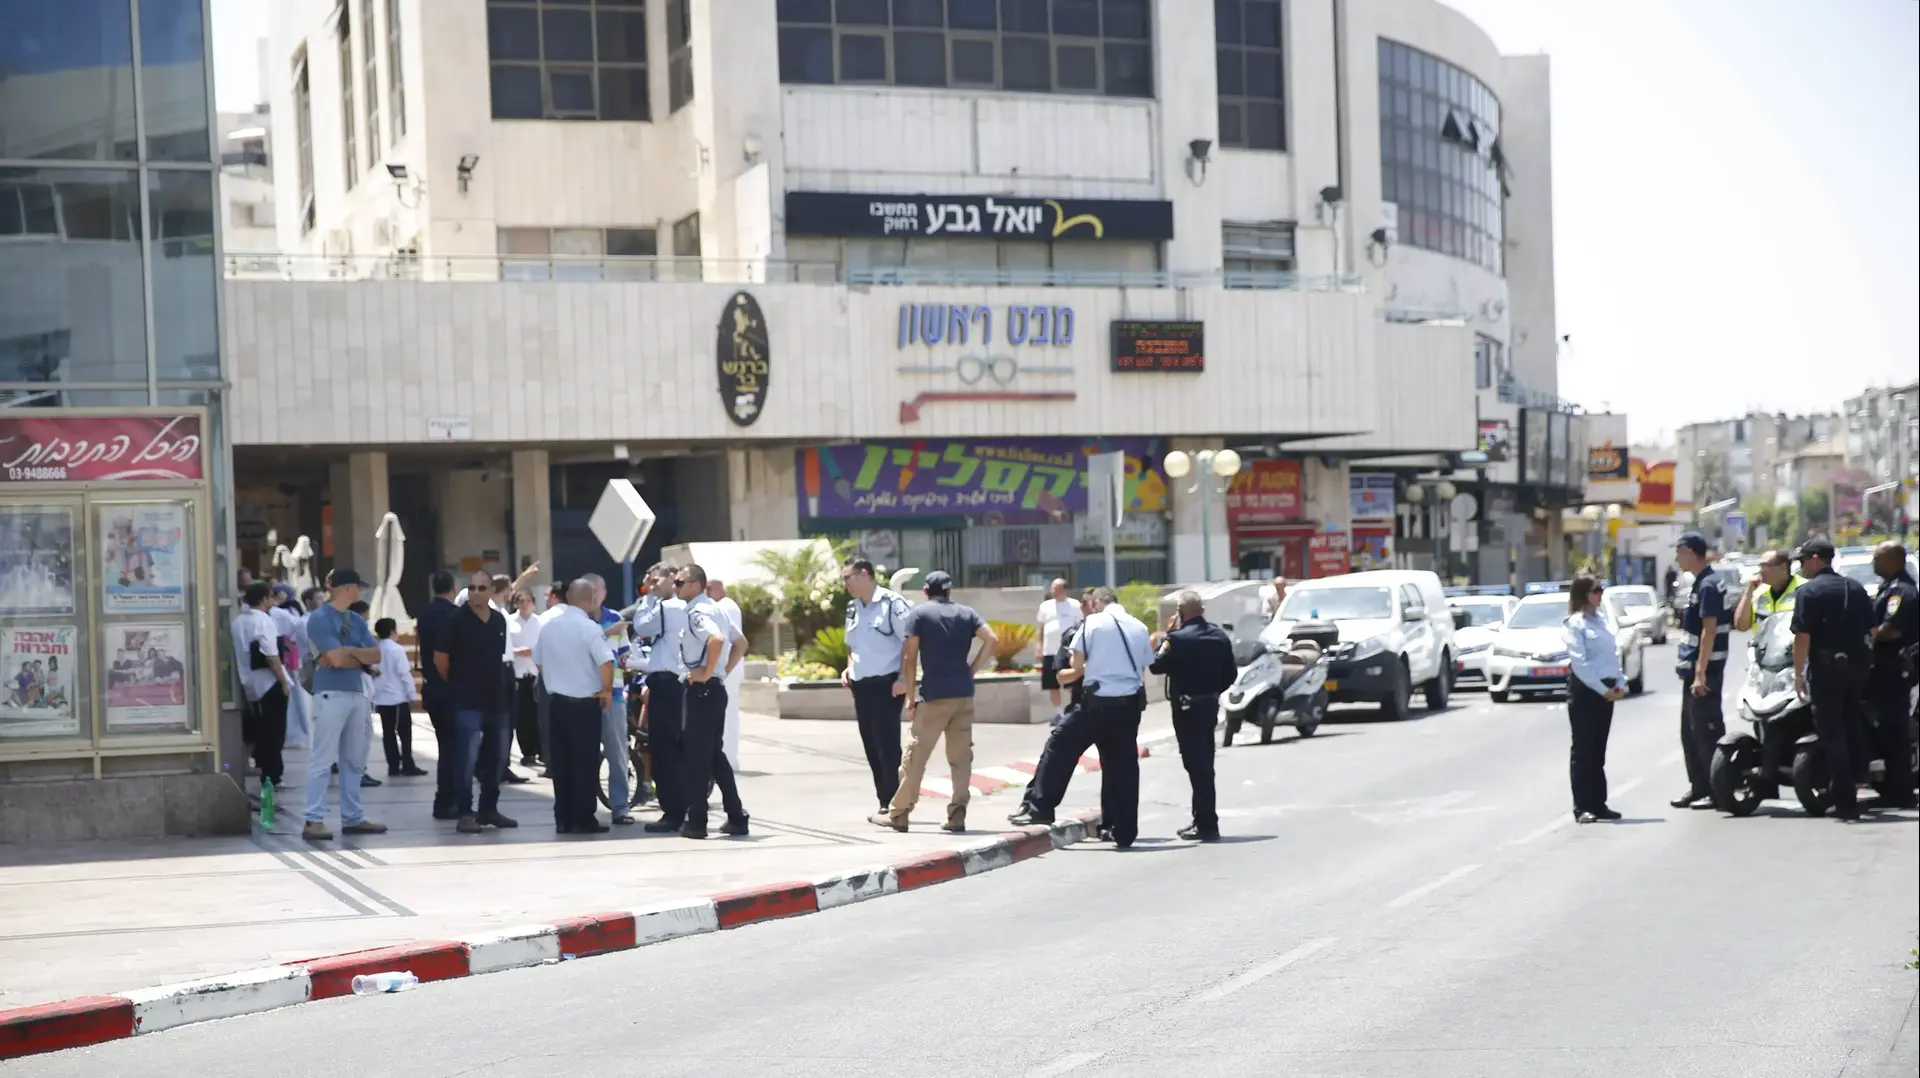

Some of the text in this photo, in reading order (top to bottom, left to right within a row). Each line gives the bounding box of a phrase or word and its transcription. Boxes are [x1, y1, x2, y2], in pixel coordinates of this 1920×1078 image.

[869, 202, 918, 217] תחשבו
[884, 216, 918, 235] רחוק
[925, 197, 1043, 235] יואל גבע
[898, 304, 1075, 351] מבט ראשון
[3, 415, 199, 469] היכל התרבות
[855, 443, 1136, 510] קסליין
